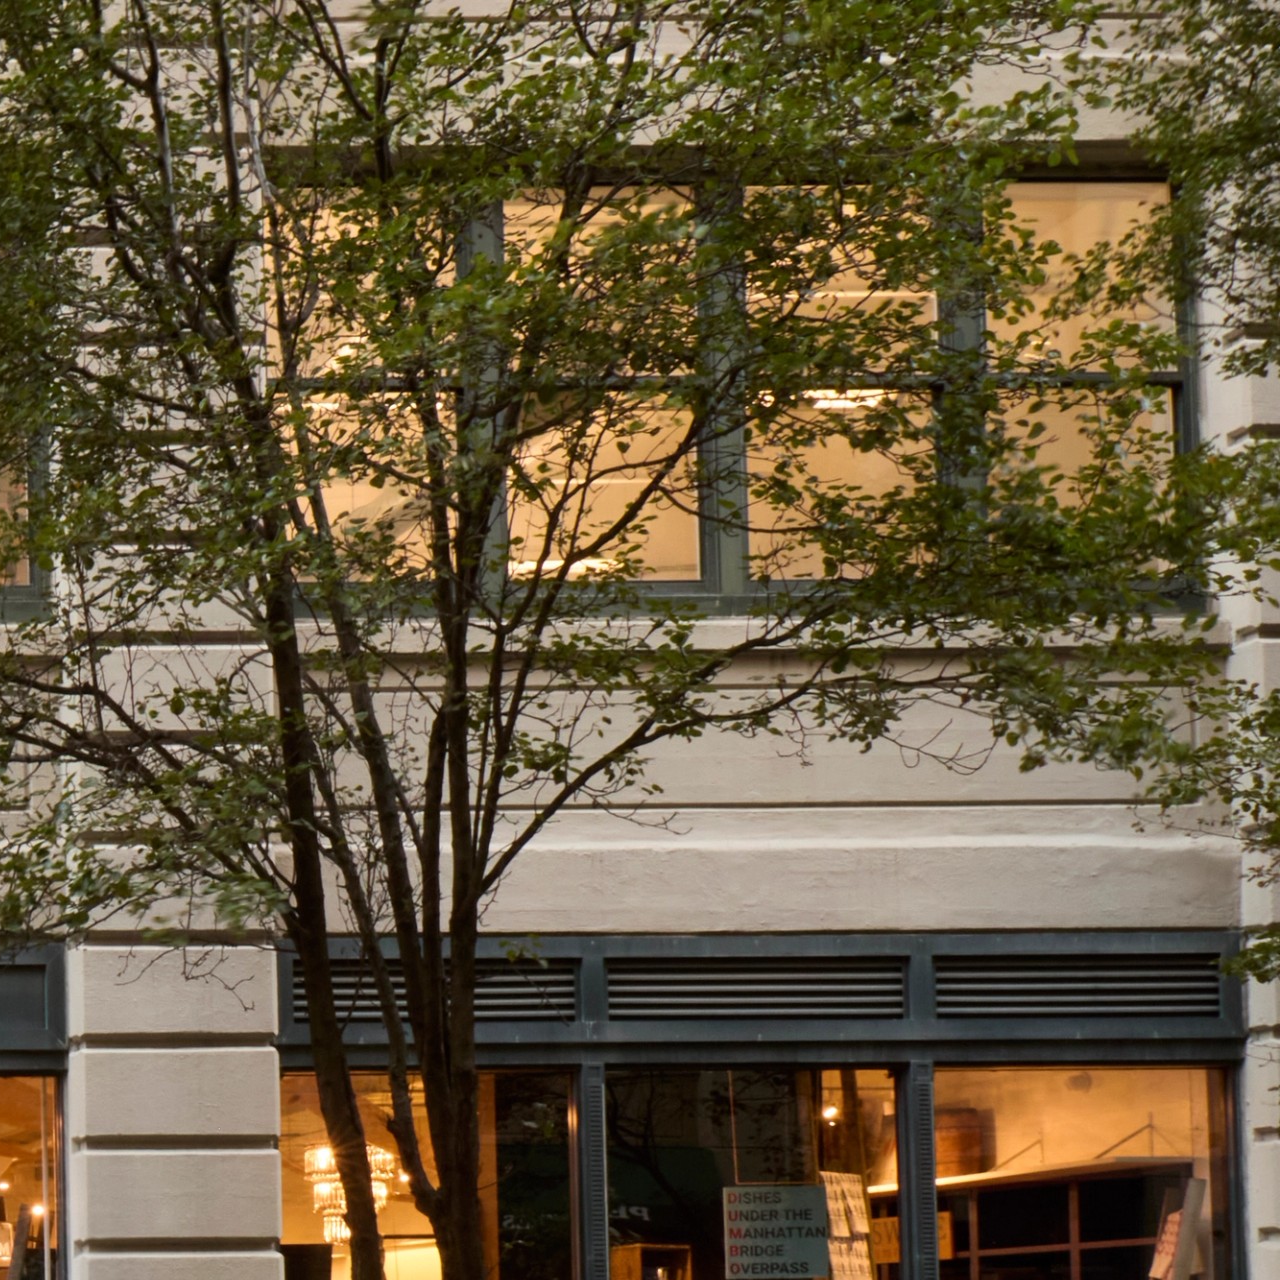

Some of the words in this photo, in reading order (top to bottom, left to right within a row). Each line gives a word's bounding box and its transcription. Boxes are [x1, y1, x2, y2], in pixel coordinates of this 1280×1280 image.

[728, 1192, 782, 1204] DISHES
[728, 1210, 778, 1222] UNDER
[784, 1209, 813, 1221] THE
[729, 1226, 826, 1239] MANHATTAN
[729, 1245, 784, 1257] BRIDGE
[730, 1262, 809, 1274] OVERPASS
